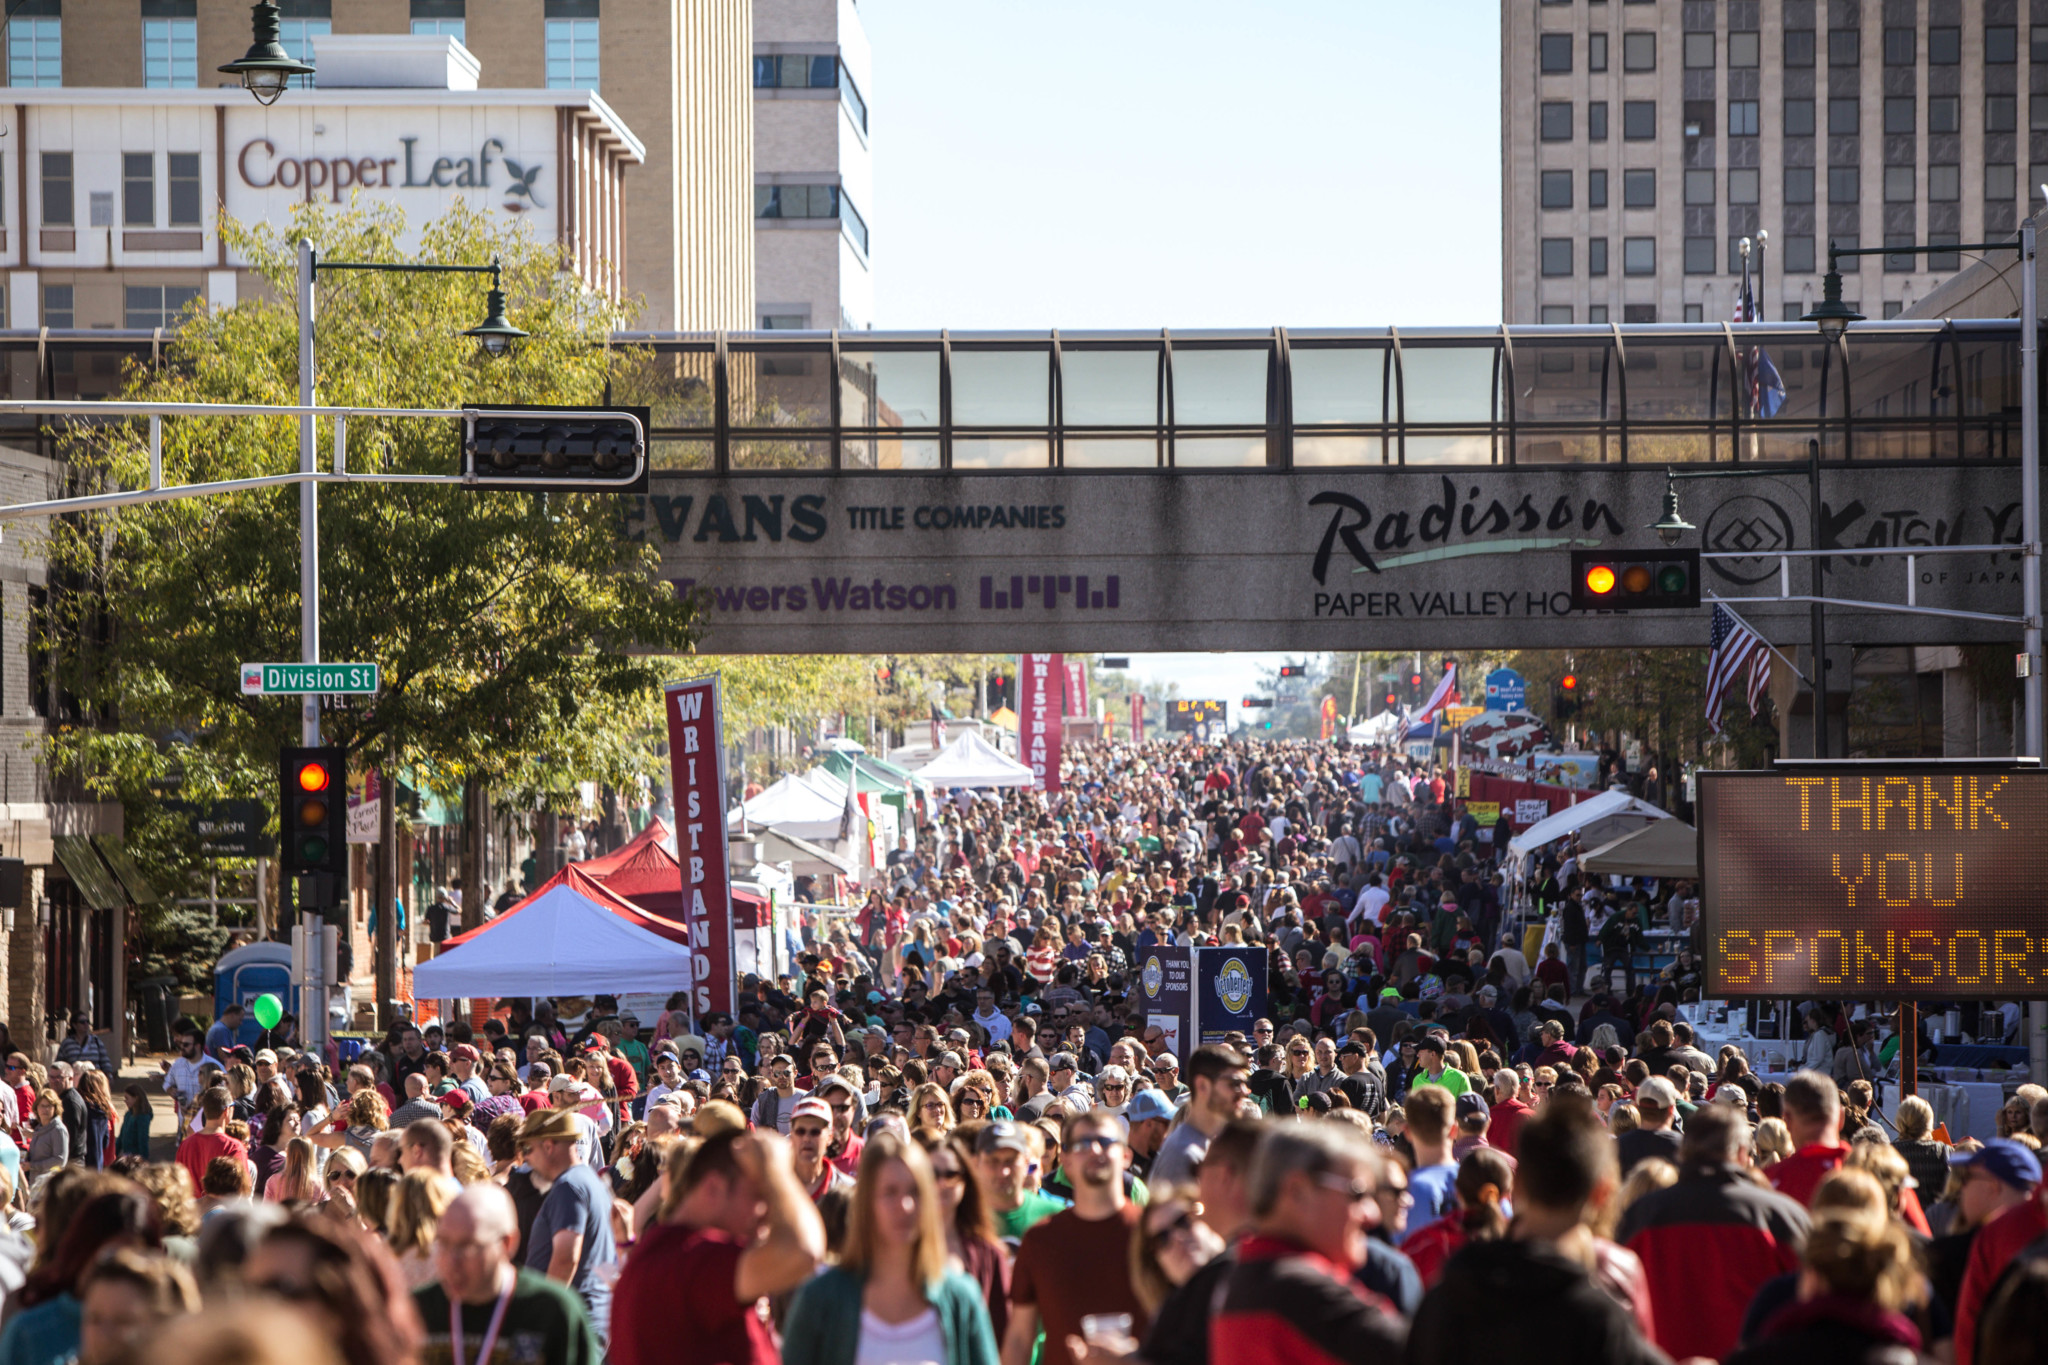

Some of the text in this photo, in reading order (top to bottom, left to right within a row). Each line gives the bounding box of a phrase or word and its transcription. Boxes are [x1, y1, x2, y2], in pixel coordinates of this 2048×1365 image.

[846, 506, 905, 530] TITLE
[913, 504, 1066, 529] COMPANIES
[1308, 475, 1625, 586] Radisson
[1921, 571, 2022, 585] OF JAPA
[811, 576, 957, 611] Watson
[1314, 592, 1403, 617] PAPER
[1409, 592, 1518, 617] VALLEY
[268, 668, 371, 688] Division St
[1030, 653, 1051, 791] WRISTBANDS
[1786, 776, 2009, 831] THANK
[677, 691, 711, 1015] WRISTBANDS
[1197, 884, 1204, 898] 7
[1832, 853, 1963, 907] YOU
[1165, 960, 1179, 968] THANK
[1719, 930, 2048, 984] SPONSOR
[1165, 982, 1188, 991] SPONSORS
[1168, 971, 1174, 980] TO
[1175, 971, 1185, 980] OUR
[1214, 971, 1253, 998] Octoberfest
